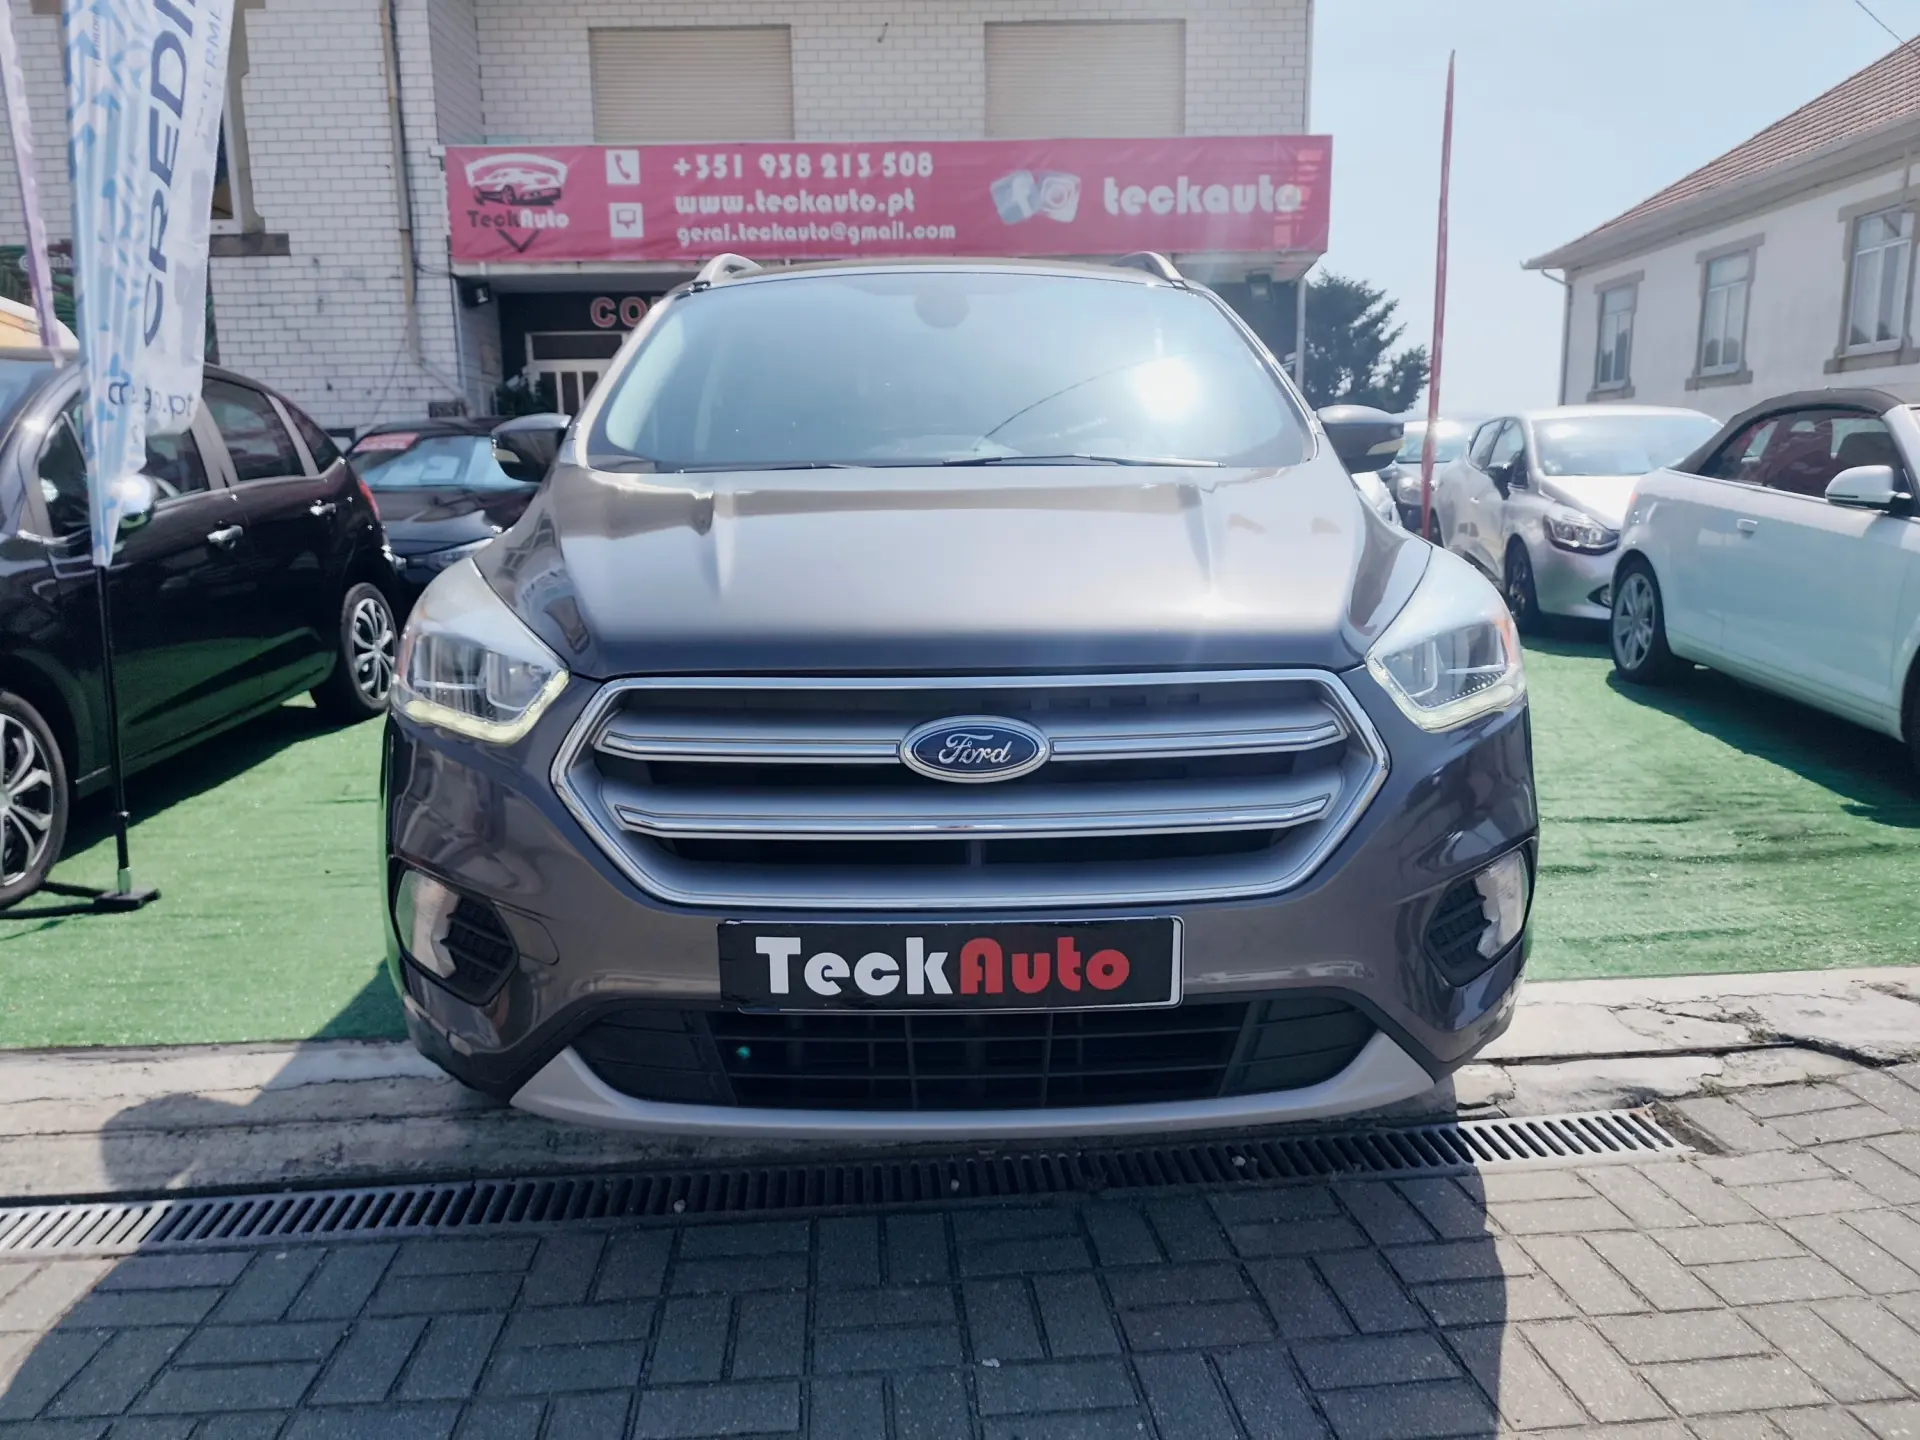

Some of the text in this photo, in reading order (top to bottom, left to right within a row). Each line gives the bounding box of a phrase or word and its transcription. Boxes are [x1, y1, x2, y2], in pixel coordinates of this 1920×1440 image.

[143, 0, 196, 347] CREDI
[673, 151, 934, 179] +351 938 213 508
[675, 187, 915, 217] www.teckauto.pt
[1103, 174, 1301, 216] teckauto
[466, 208, 570, 229] TeckAuto
[590, 296, 663, 329] CO
[938, 733, 1013, 765] Ford
[755, 936, 1131, 996] TeckAuto
